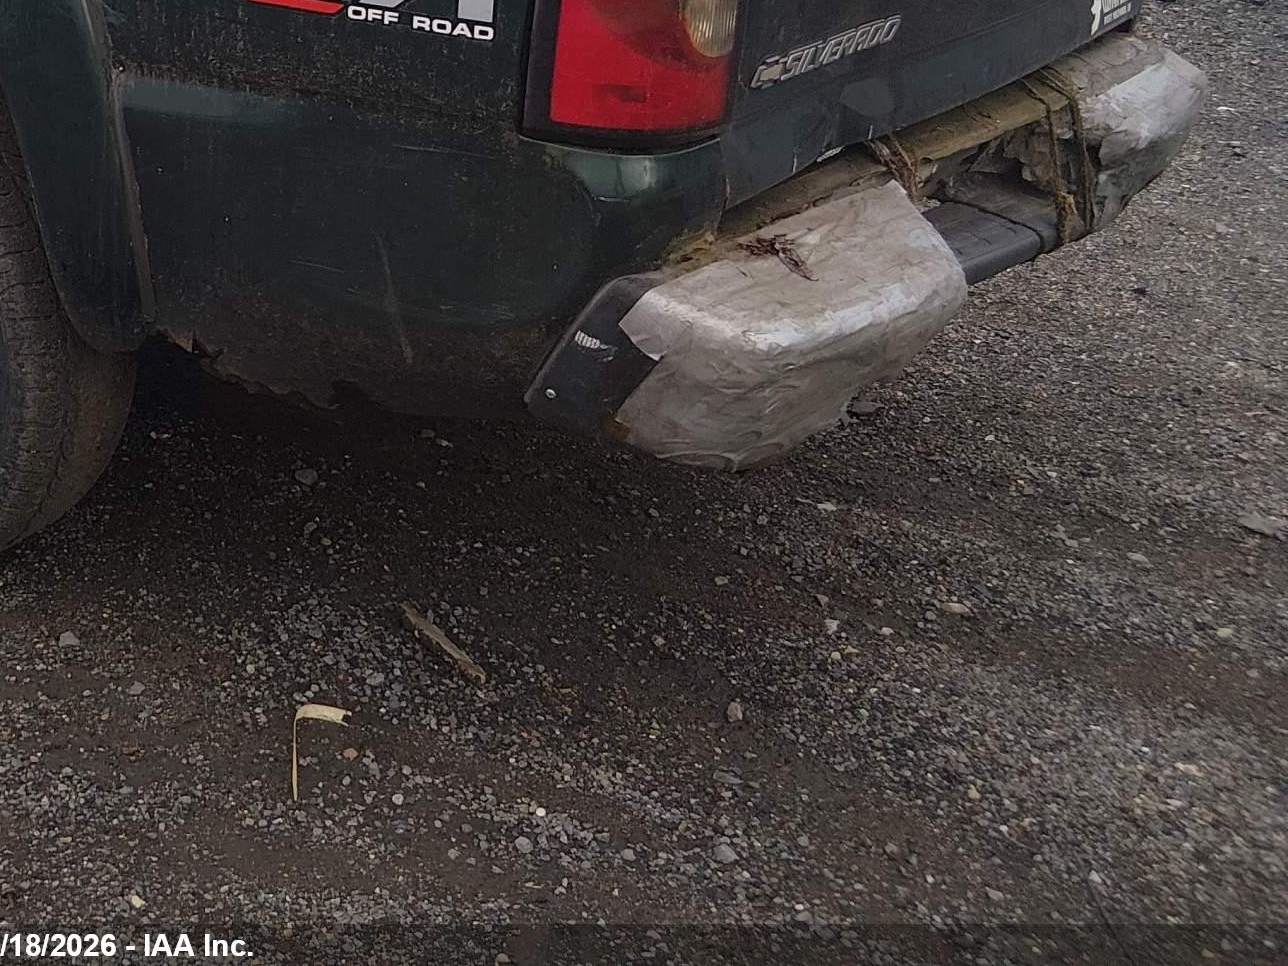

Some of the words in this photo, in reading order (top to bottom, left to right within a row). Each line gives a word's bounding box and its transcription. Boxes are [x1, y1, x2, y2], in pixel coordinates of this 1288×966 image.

[347, 5, 400, 26] OFF
[412, 15, 495, 42] ROAD
[780, 13, 902, 82] SILVERADO
